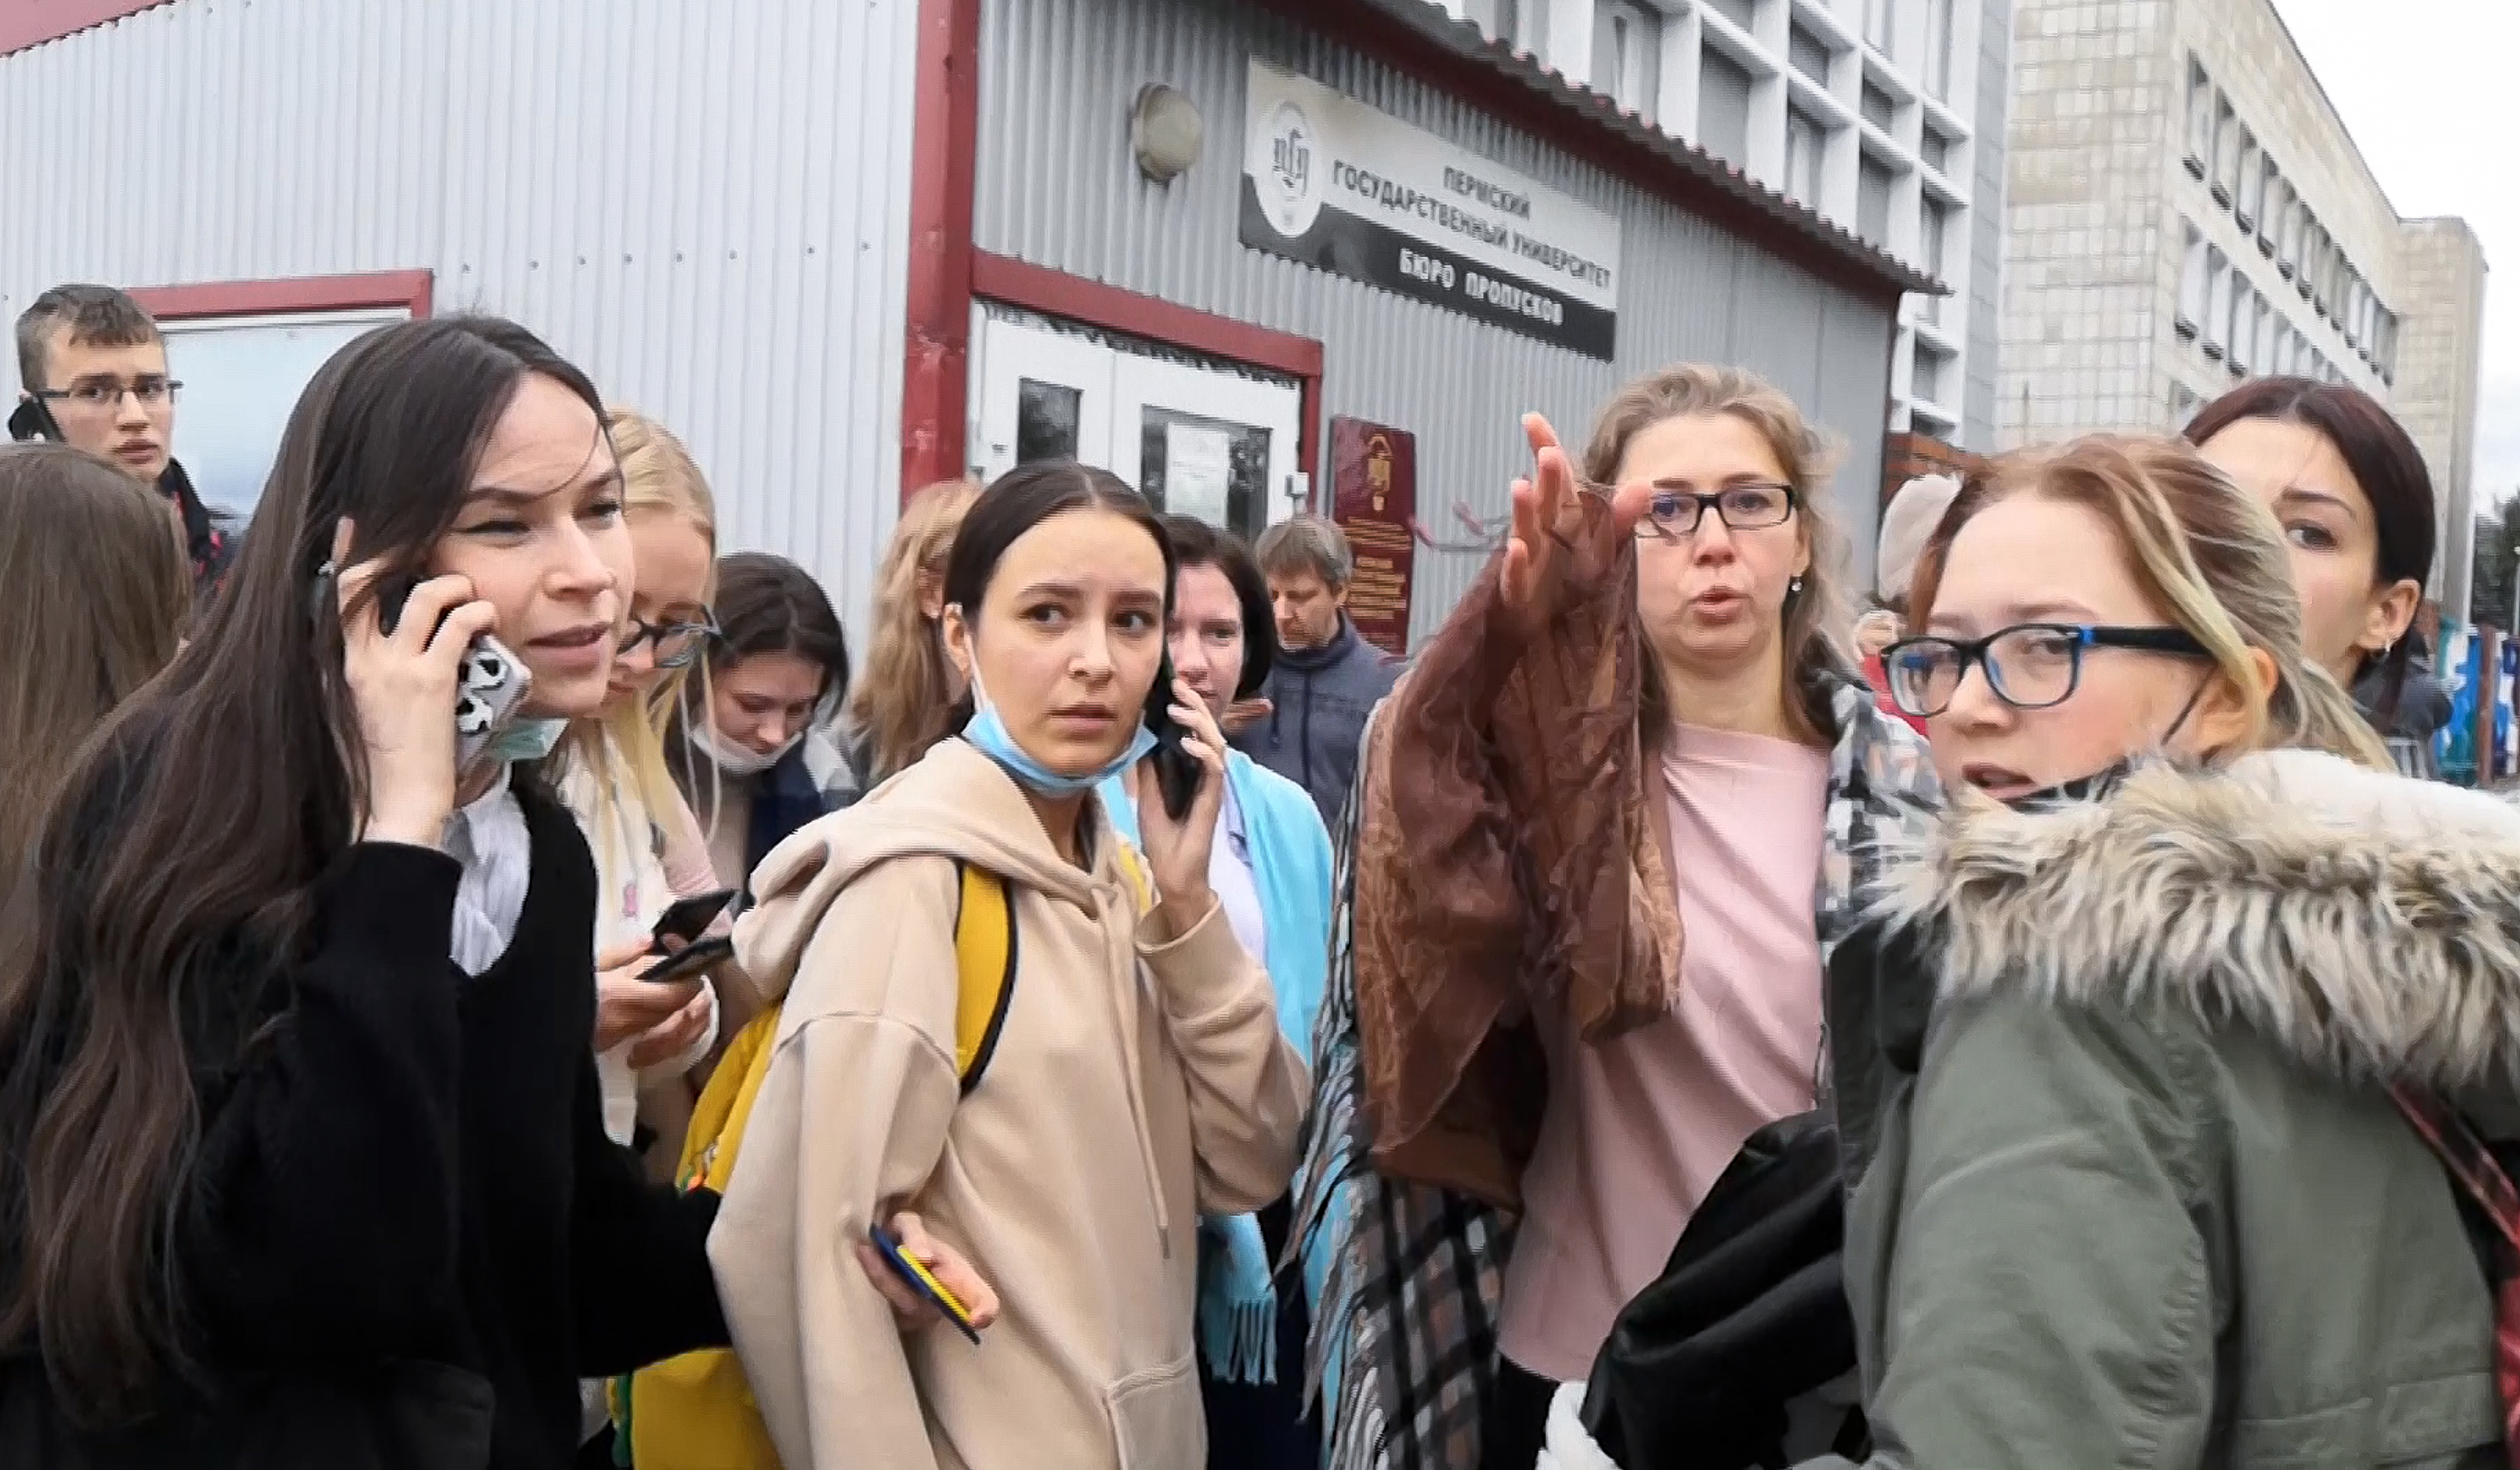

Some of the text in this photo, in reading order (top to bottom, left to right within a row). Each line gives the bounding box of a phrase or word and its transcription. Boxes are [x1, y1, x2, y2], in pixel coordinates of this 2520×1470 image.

[1333, 159, 1610, 287] ГОСУДАРСТВЕННЫЙ УНИВЕРСИТЕТ
[1444, 165, 1529, 220] ПЕРМСКИЙ
[1400, 248, 1563, 326] БЮРО ПРОПУСКОВ
